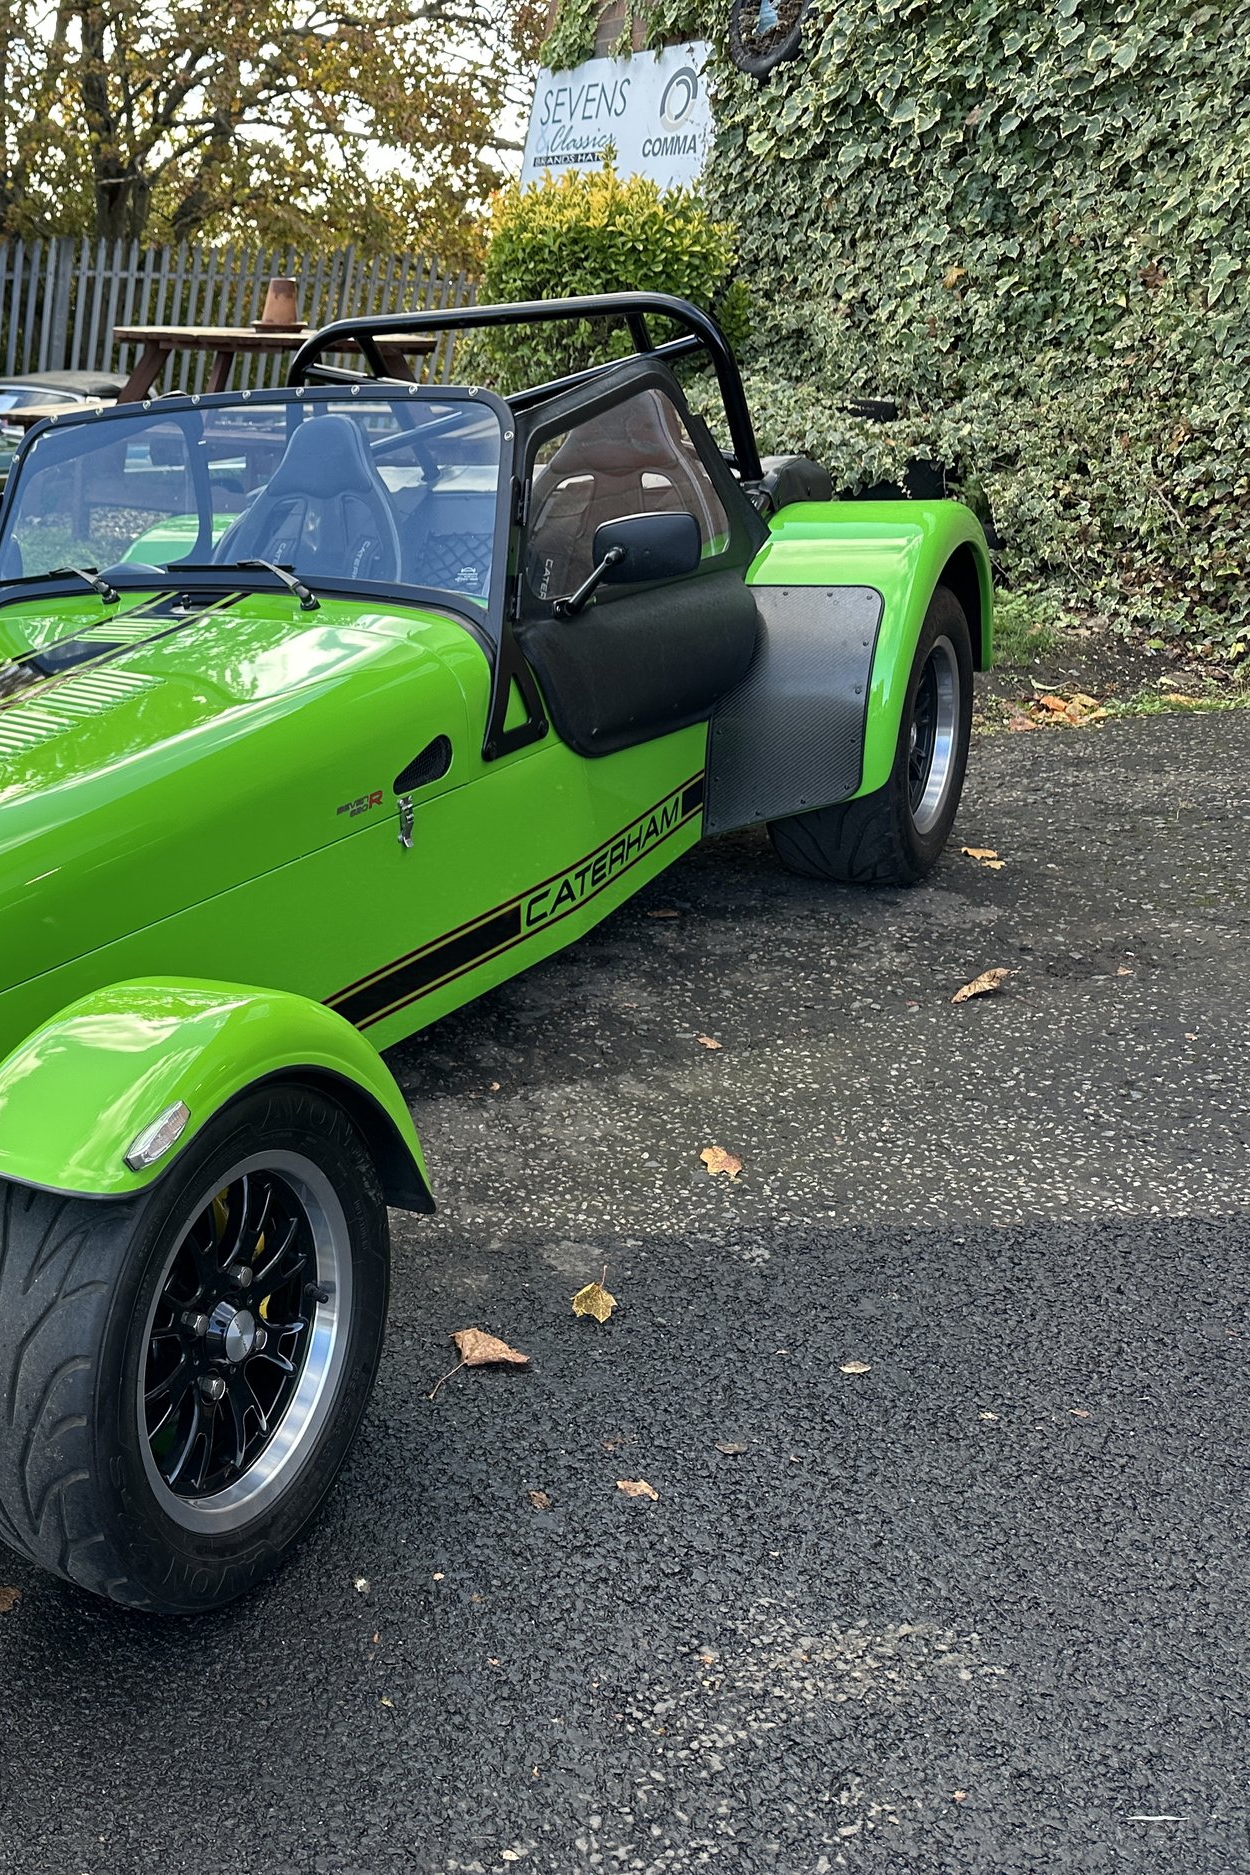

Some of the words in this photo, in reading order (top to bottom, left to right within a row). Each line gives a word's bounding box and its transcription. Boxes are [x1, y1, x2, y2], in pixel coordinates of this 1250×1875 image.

[540, 78, 631, 126] SEVENS
[551, 125, 616, 153] Classics
[642, 134, 697, 158] COMMA
[534, 154, 575, 166] BRANDS
[526, 796, 680, 927] CATERHAM
